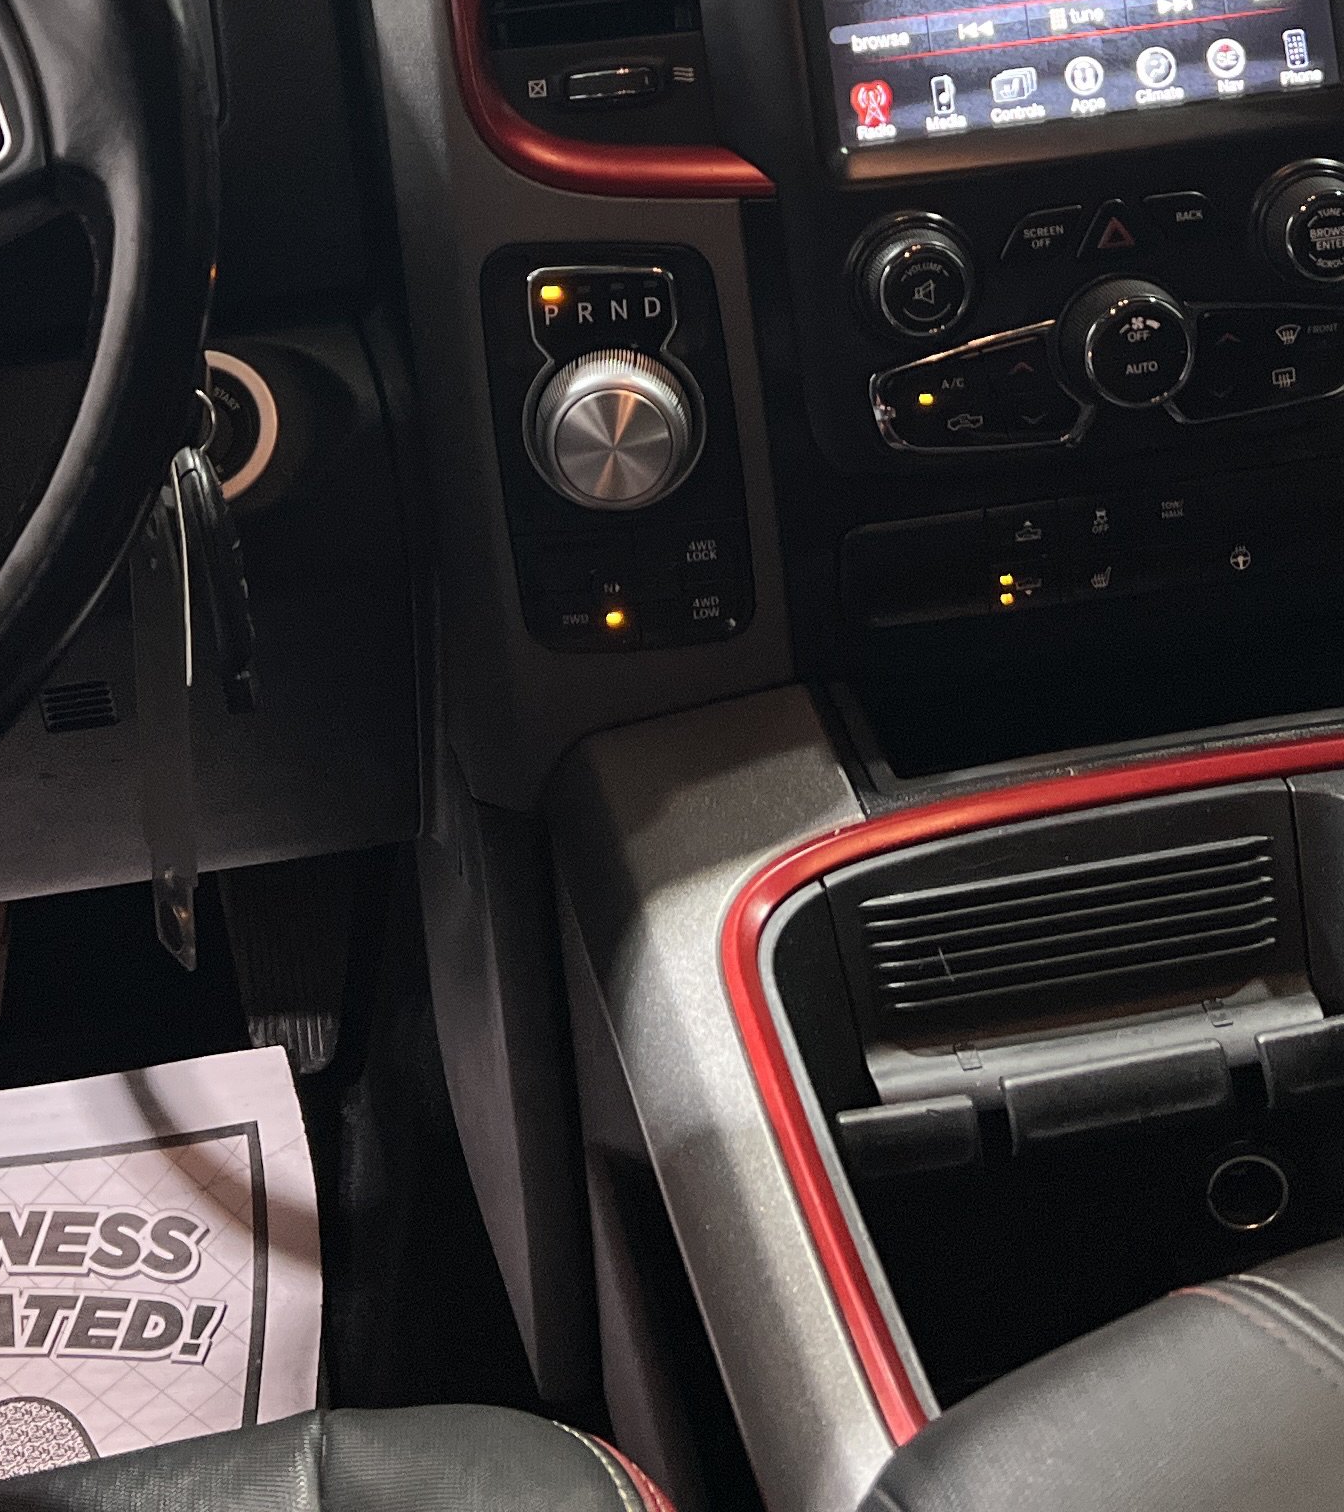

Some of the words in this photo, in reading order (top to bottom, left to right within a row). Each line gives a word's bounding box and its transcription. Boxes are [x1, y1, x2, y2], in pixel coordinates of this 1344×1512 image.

[1070, 7, 1104, 25] tune
[851, 32, 910, 53] browse
[1279, 67, 1324, 86] Phone
[1135, 86, 1185, 104] Climate
[1071, 96, 1106, 115] Apps
[990, 103, 1046, 124] Controls
[856, 124, 897, 141] Radio
[1176, 209, 1204, 223] BACK
[1317, 207, 1343, 219] TUNE
[1023, 224, 1065, 238] SCREEN
[1032, 238, 1051, 250] OFF
[906, 262, 944, 277] VOLUME
[578, 304, 594, 324] R
[610, 299, 628, 321] N
[644, 296, 662, 319] D
[1127, 329, 1151, 343] OFF
[1125, 360, 1159, 375] AUTO
[940, 377, 966, 389] A/C
[687, 539, 718, 553] 4WD
[686, 550, 718, 564] LOCK
[691, 595, 720, 609] 4WD
[693, 607, 720, 620] LOW
